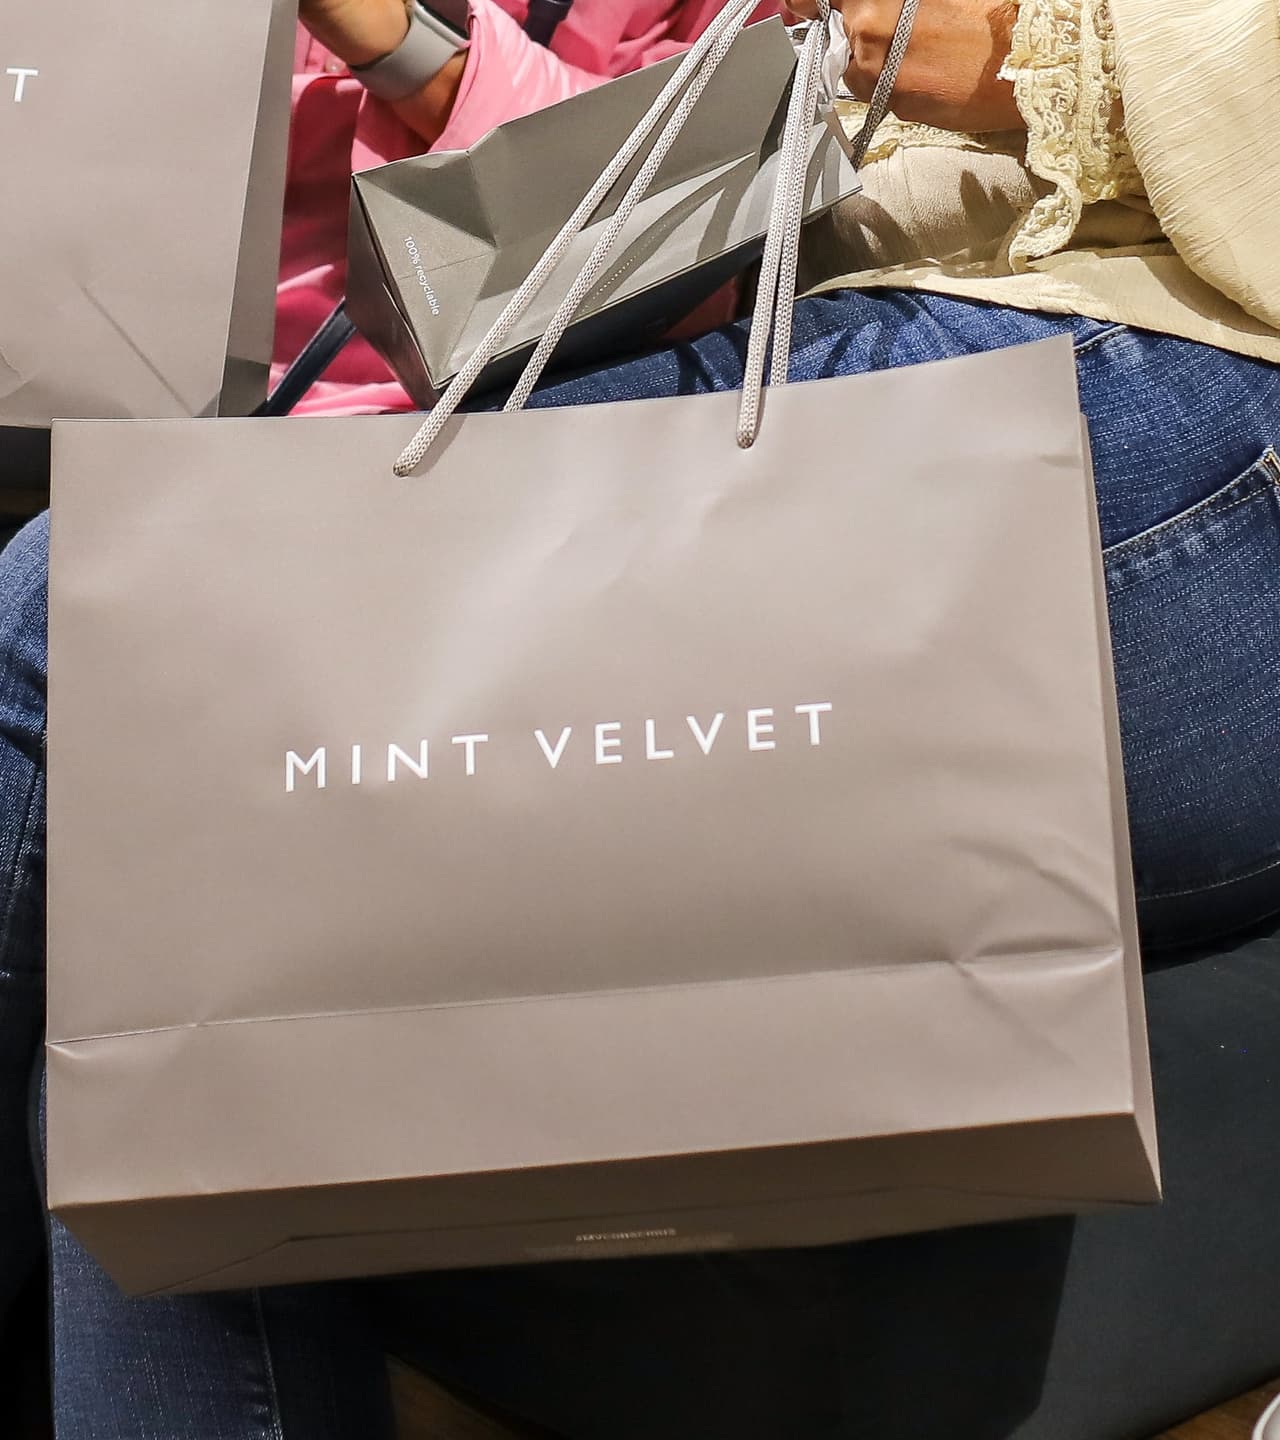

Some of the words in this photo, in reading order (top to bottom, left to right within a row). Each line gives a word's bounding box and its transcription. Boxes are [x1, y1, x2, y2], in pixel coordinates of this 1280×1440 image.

[404, 236, 421, 265] 100%
[415, 265, 440, 316] recyclable
[285, 733, 489, 792] MINT
[534, 701, 832, 768] VELVET
